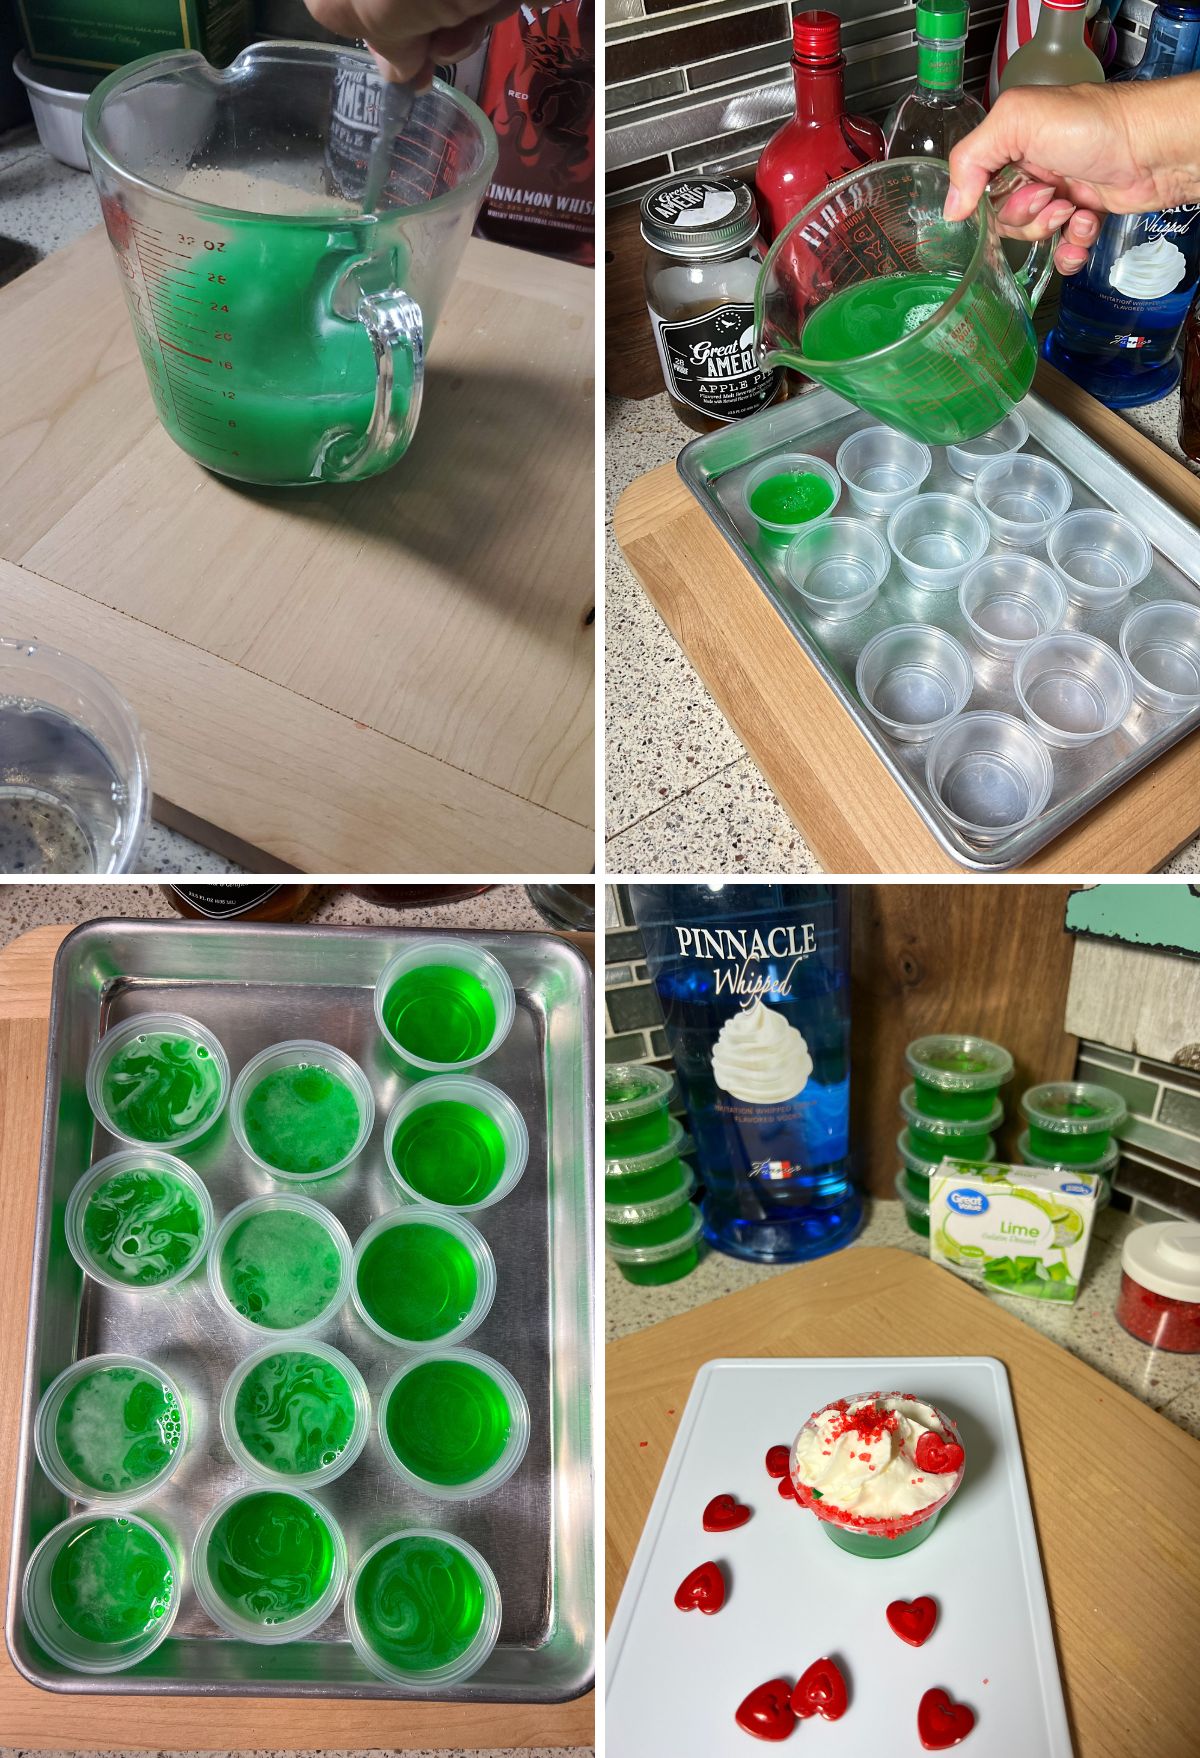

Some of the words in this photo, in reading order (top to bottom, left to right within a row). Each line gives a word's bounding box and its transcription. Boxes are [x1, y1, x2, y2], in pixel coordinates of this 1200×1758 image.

[508, 89, 529, 101] RED
[655, 183, 693, 204] Great
[207, 272, 226, 285] 28
[210, 302, 229, 313] 24
[689, 340, 739, 366] Great
[698, 379, 748, 394] APPLE
[222, 391, 236, 401] 12
[675, 923, 817, 960] PINNACLE
[713, 954, 803, 1014] Whipped
[951, 1193, 982, 1206] Great
[1000, 1220, 1040, 1238] Lime
